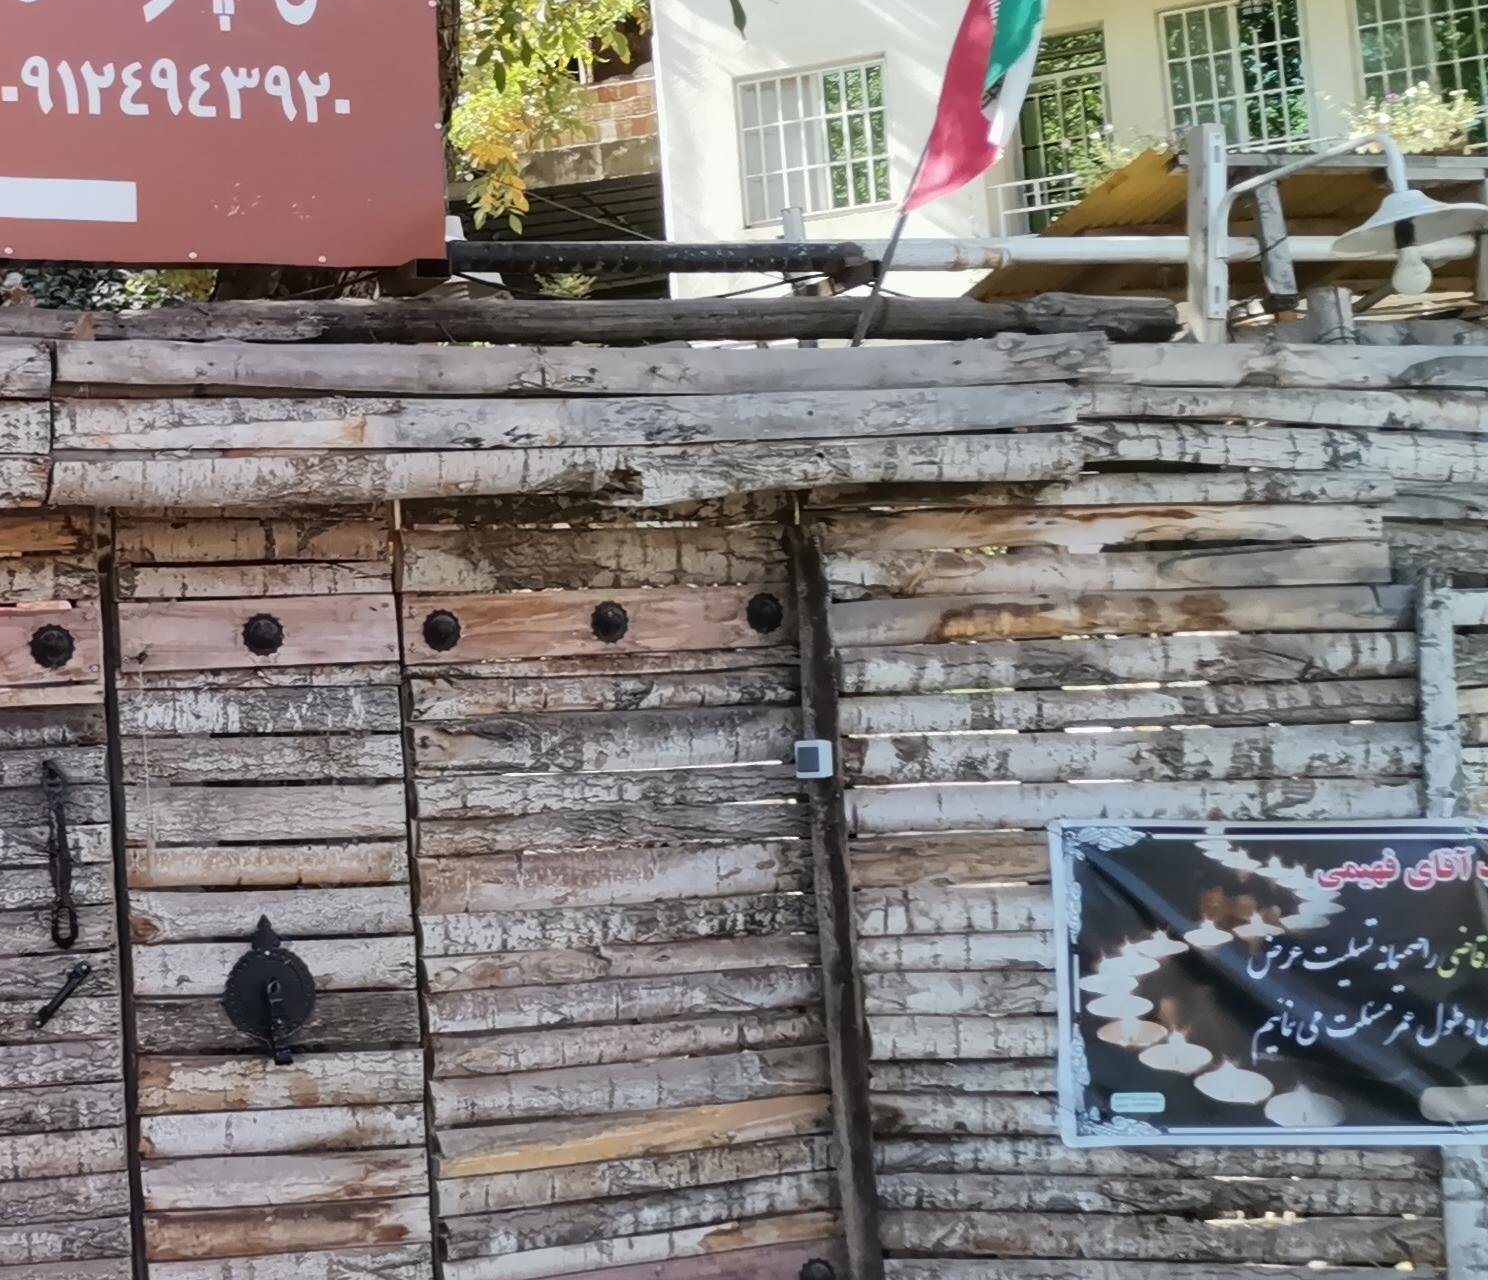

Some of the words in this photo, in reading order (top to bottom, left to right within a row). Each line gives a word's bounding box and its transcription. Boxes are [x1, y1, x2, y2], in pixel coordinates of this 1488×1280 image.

[1313, 847, 1401, 890] فهیمی
[1404, 846, 1476, 891] آقای
[1246, 934, 1304, 980] عرض
[1302, 917, 1378, 988] تسلیت
[1296, 1009, 1324, 1048] می
[1381, 1010, 1416, 1046] عمر
[1416, 1002, 1465, 1047] طول
